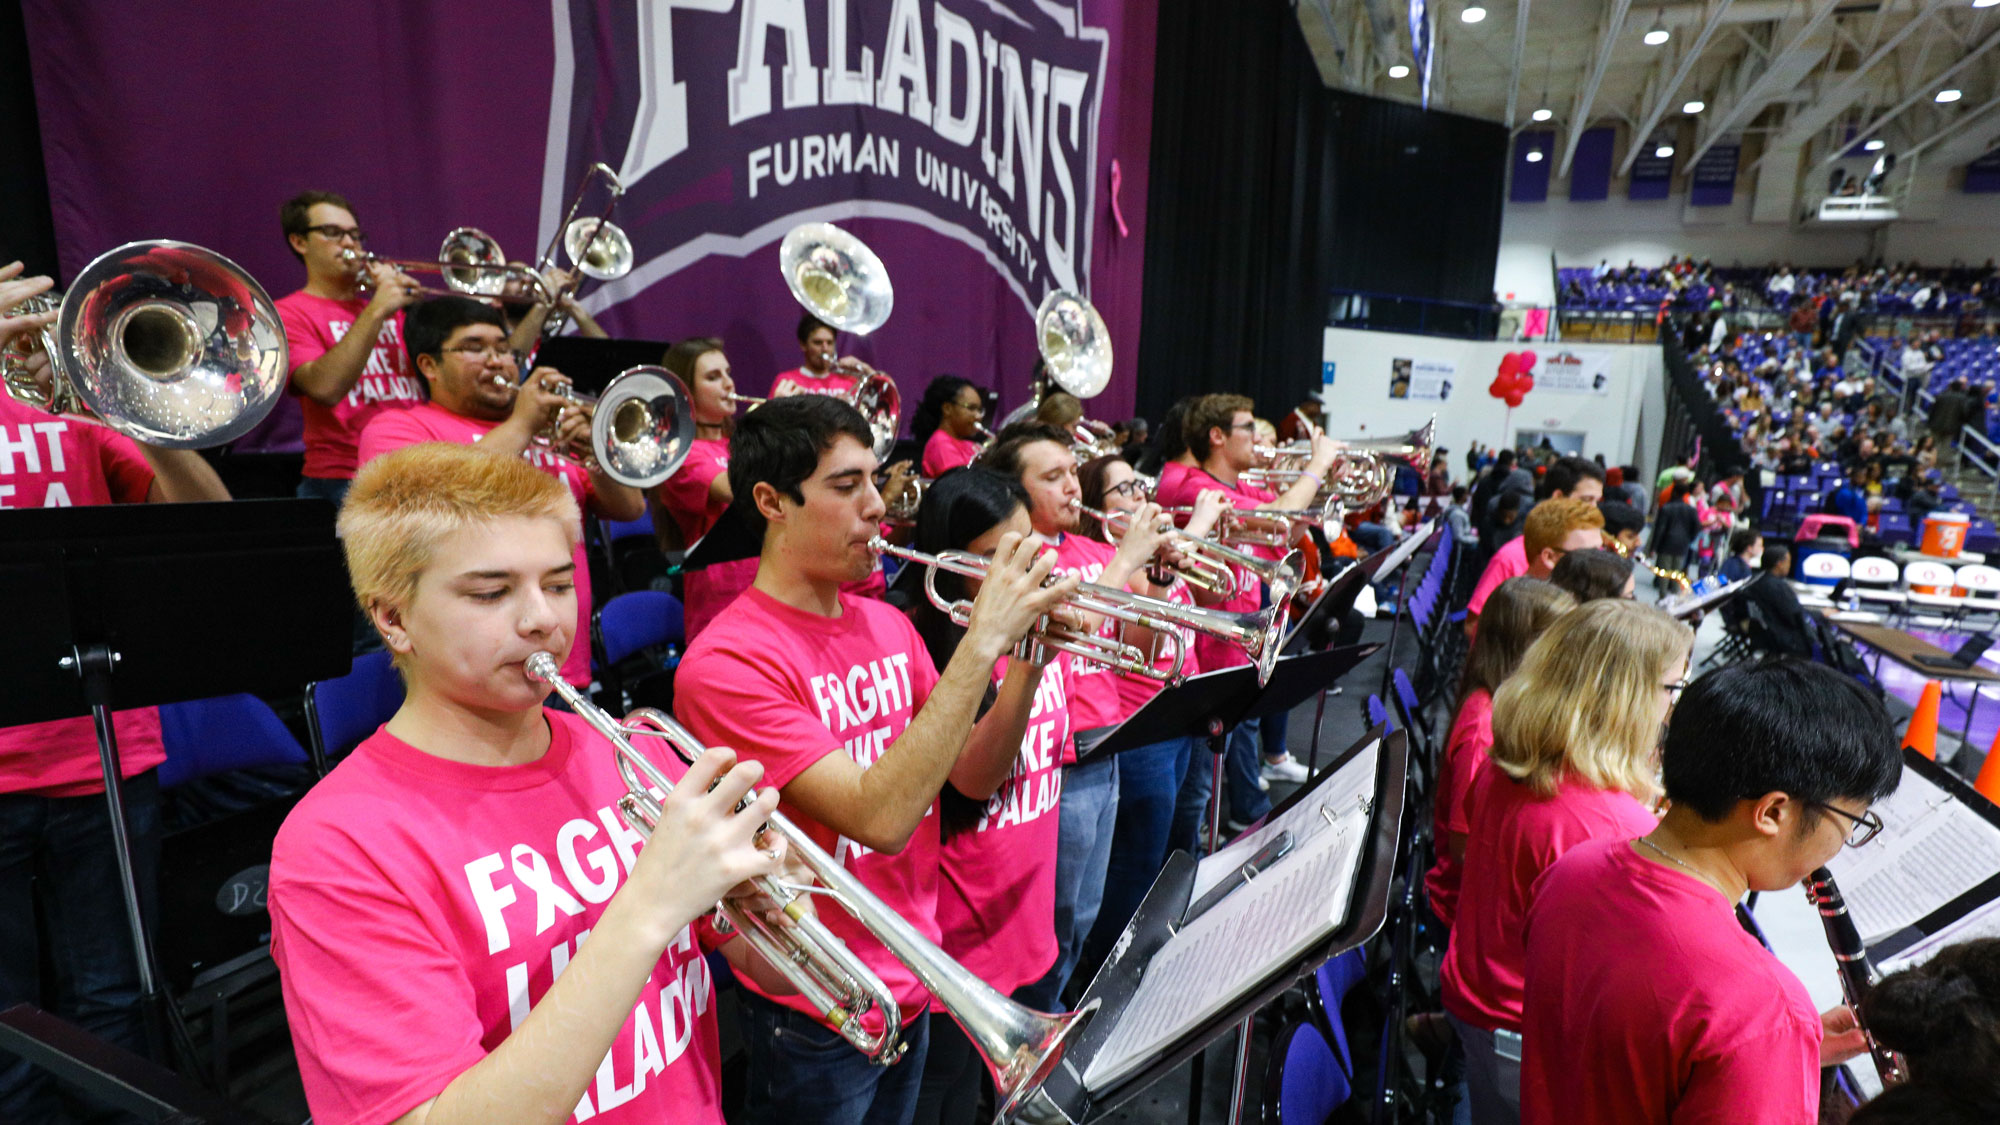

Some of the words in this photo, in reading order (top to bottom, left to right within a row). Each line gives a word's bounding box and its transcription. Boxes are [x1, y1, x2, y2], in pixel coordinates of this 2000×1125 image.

[748, 132, 900, 199] FURMAN
[915, 146, 1038, 283] UNIVERSITY
[810, 652, 913, 733] FIGHT
